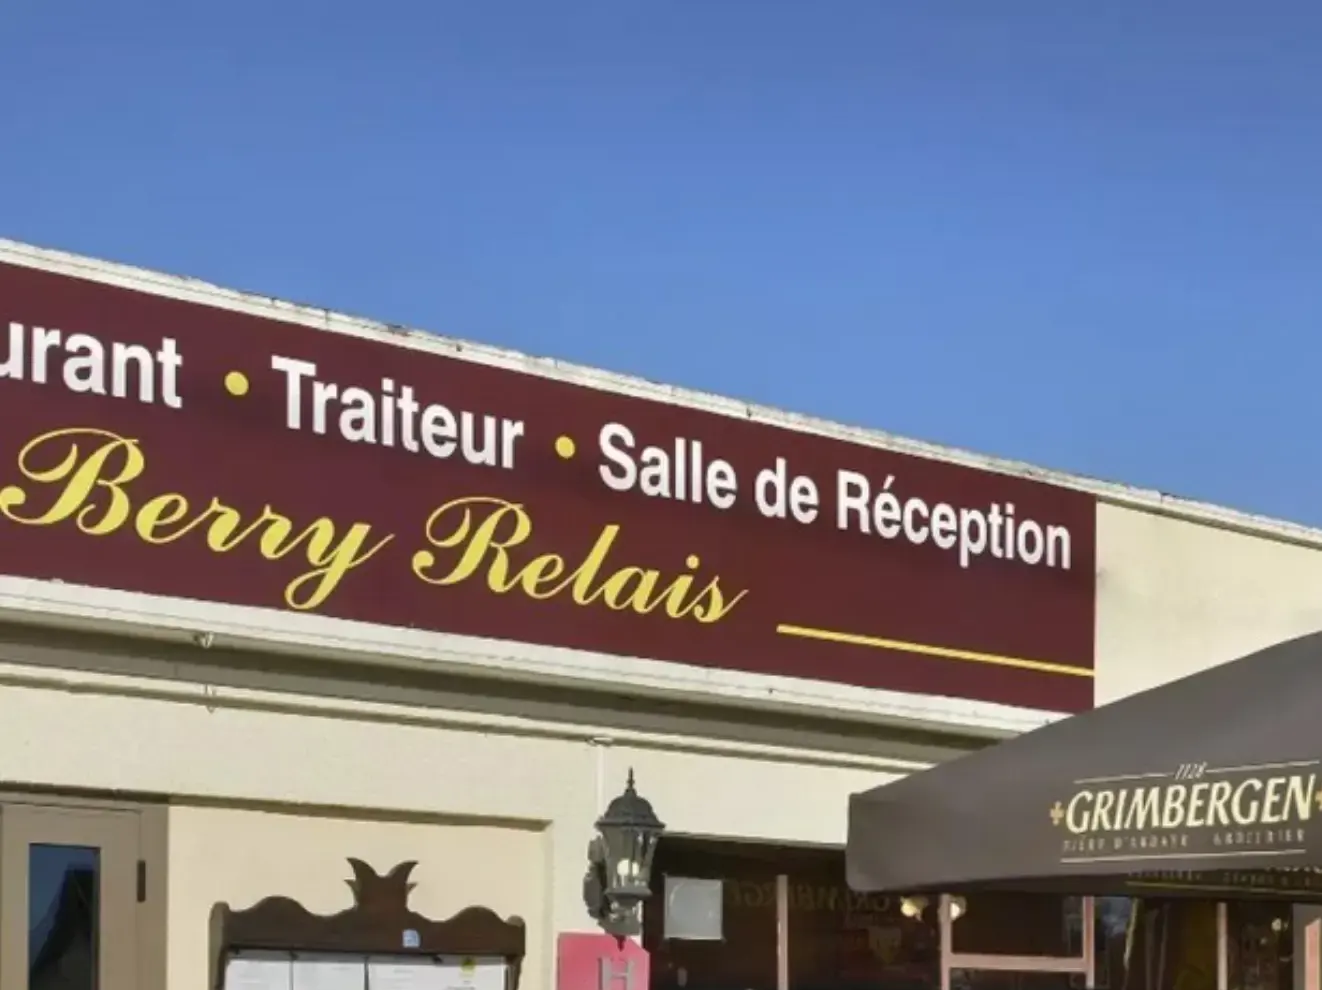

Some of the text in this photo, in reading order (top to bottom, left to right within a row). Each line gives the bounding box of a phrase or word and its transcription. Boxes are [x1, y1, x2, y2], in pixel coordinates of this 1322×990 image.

[0, 322, 1072, 569] urant Traiteur Salle de Réception
[0, 428, 749, 623] Berry Relais
[1065, 773, 1317, 834] GRIMBERGEN
